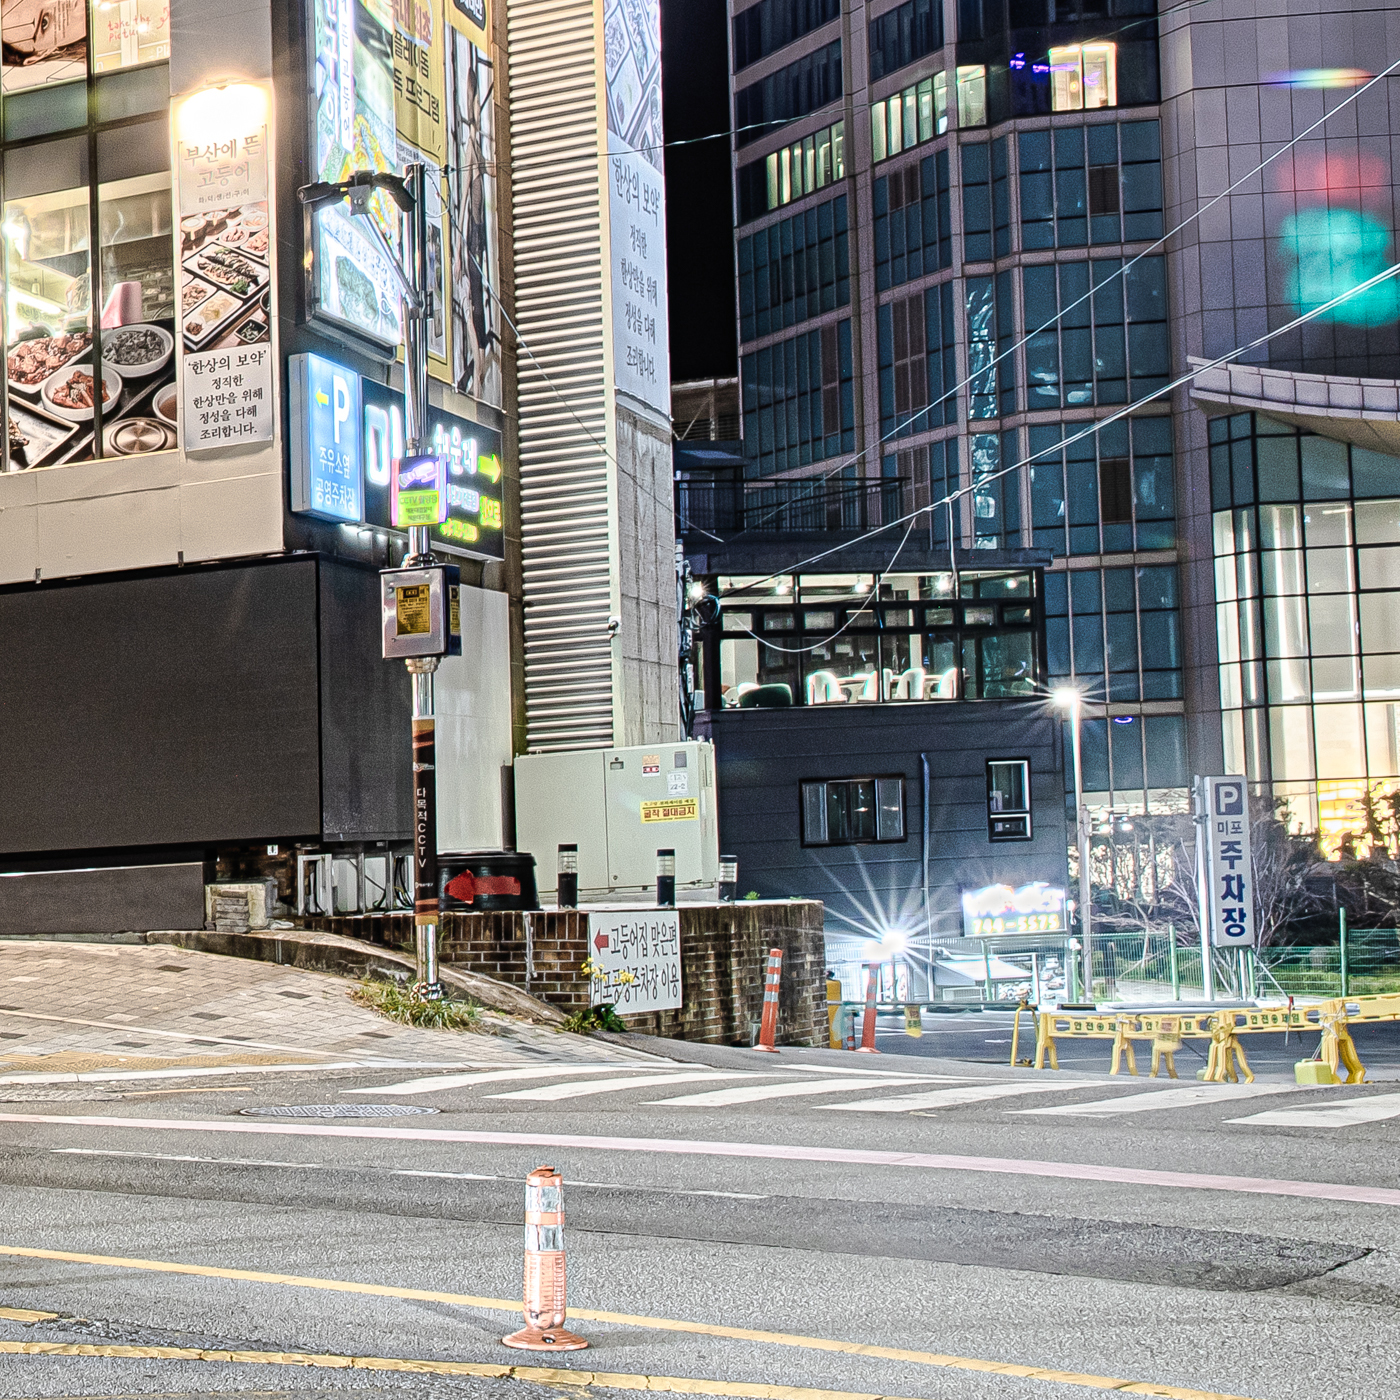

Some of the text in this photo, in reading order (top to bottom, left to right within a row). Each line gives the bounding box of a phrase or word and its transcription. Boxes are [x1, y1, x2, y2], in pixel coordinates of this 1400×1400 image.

[184, 134, 262, 166] 부산에 뜬
[197, 161, 251, 188] 고등어
[629, 224, 648, 260] 정직한
[620, 257, 658, 308] 한상만을 위해
[624, 301, 656, 345] 정성을 다해
[193, 388, 264, 409] 한상만을 위해
[211, 374, 244, 390] 정직한
[199, 404, 257, 425] 정성을 다해
[333, 375, 350, 444] P
[200, 422, 258, 440] 조리합니다.
[319, 446, 351, 480] 주유소옆
[316, 477, 356, 513] 공영주차장
[662, 806, 695, 817] 절대금지
[1219, 785, 1239, 813] P
[1218, 820, 1243, 836] 미포
[1220, 840, 1247, 938] 주차장
[611, 920, 678, 959] 고등어집 맞은편
[661, 962, 679, 999] 이용
